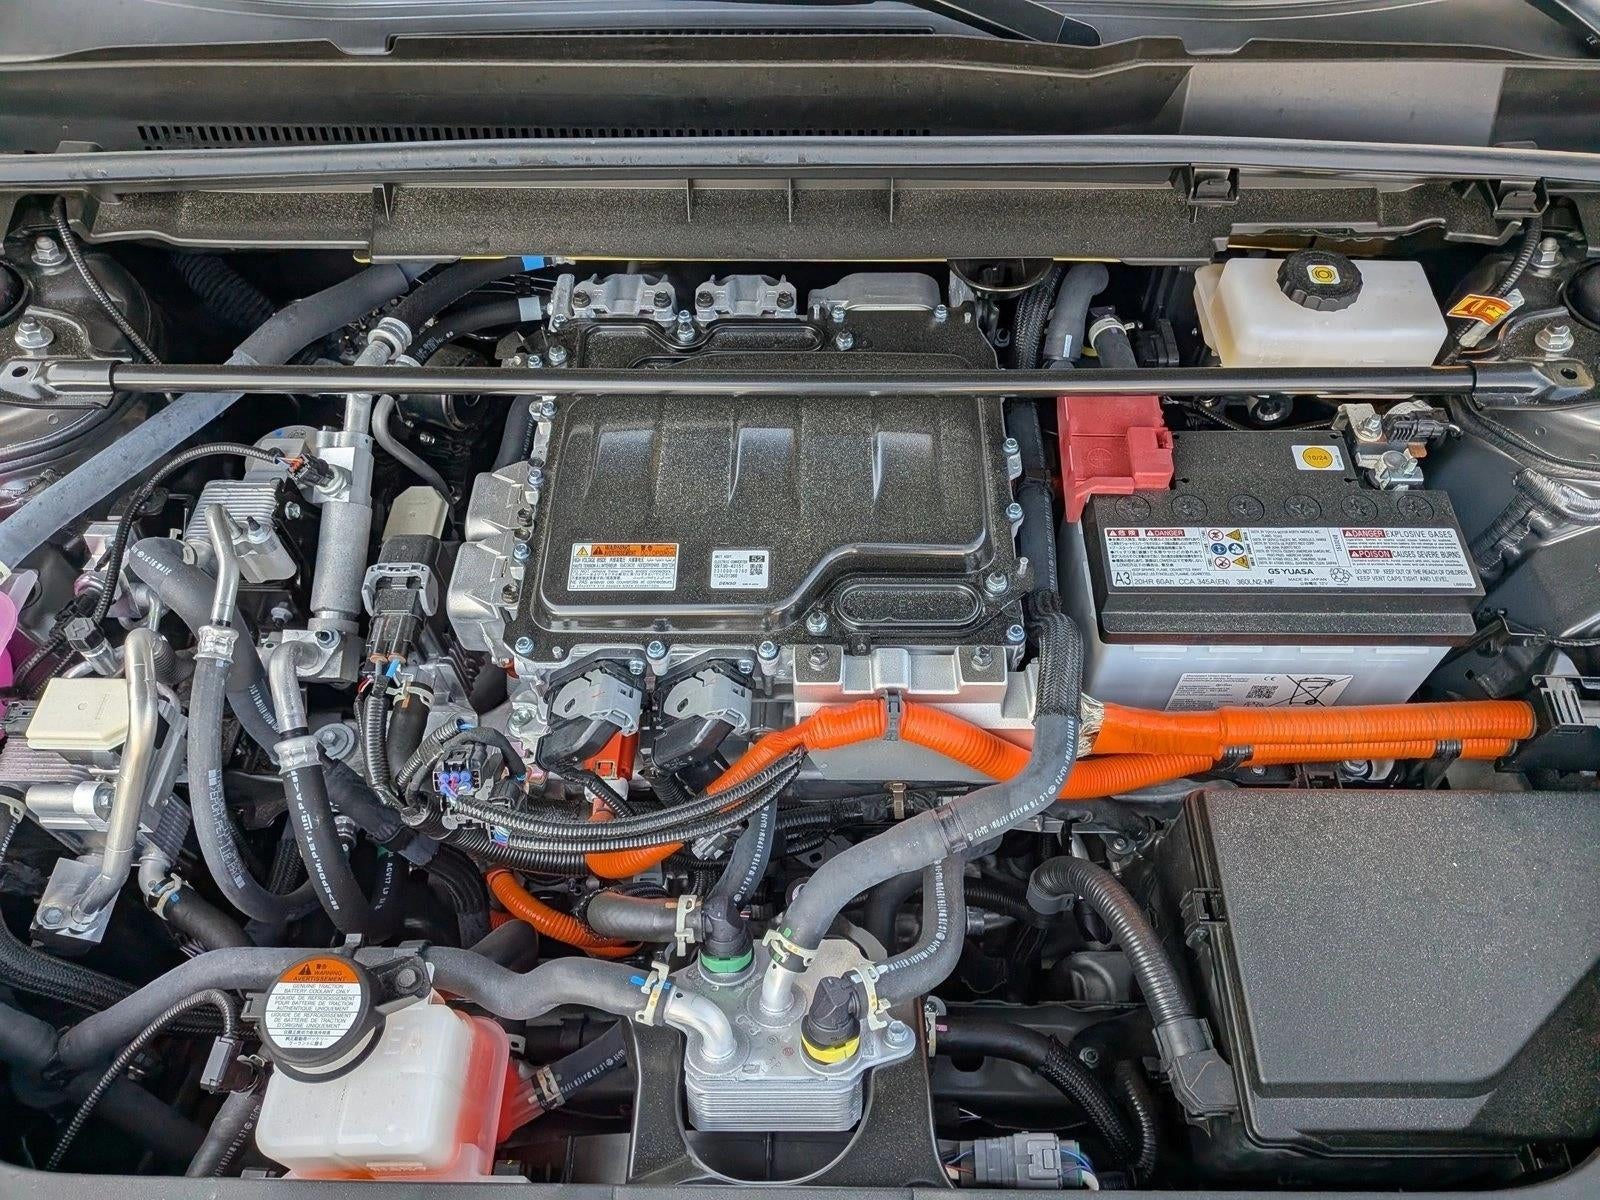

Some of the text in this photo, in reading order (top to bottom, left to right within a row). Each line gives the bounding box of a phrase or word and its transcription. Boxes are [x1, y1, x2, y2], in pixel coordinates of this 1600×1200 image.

[1115, 572, 1131, 585] A3
[1009, 804, 1029, 821] WATER
[748, 854, 761, 876] WATER
[887, 960, 911, 972] WATER
